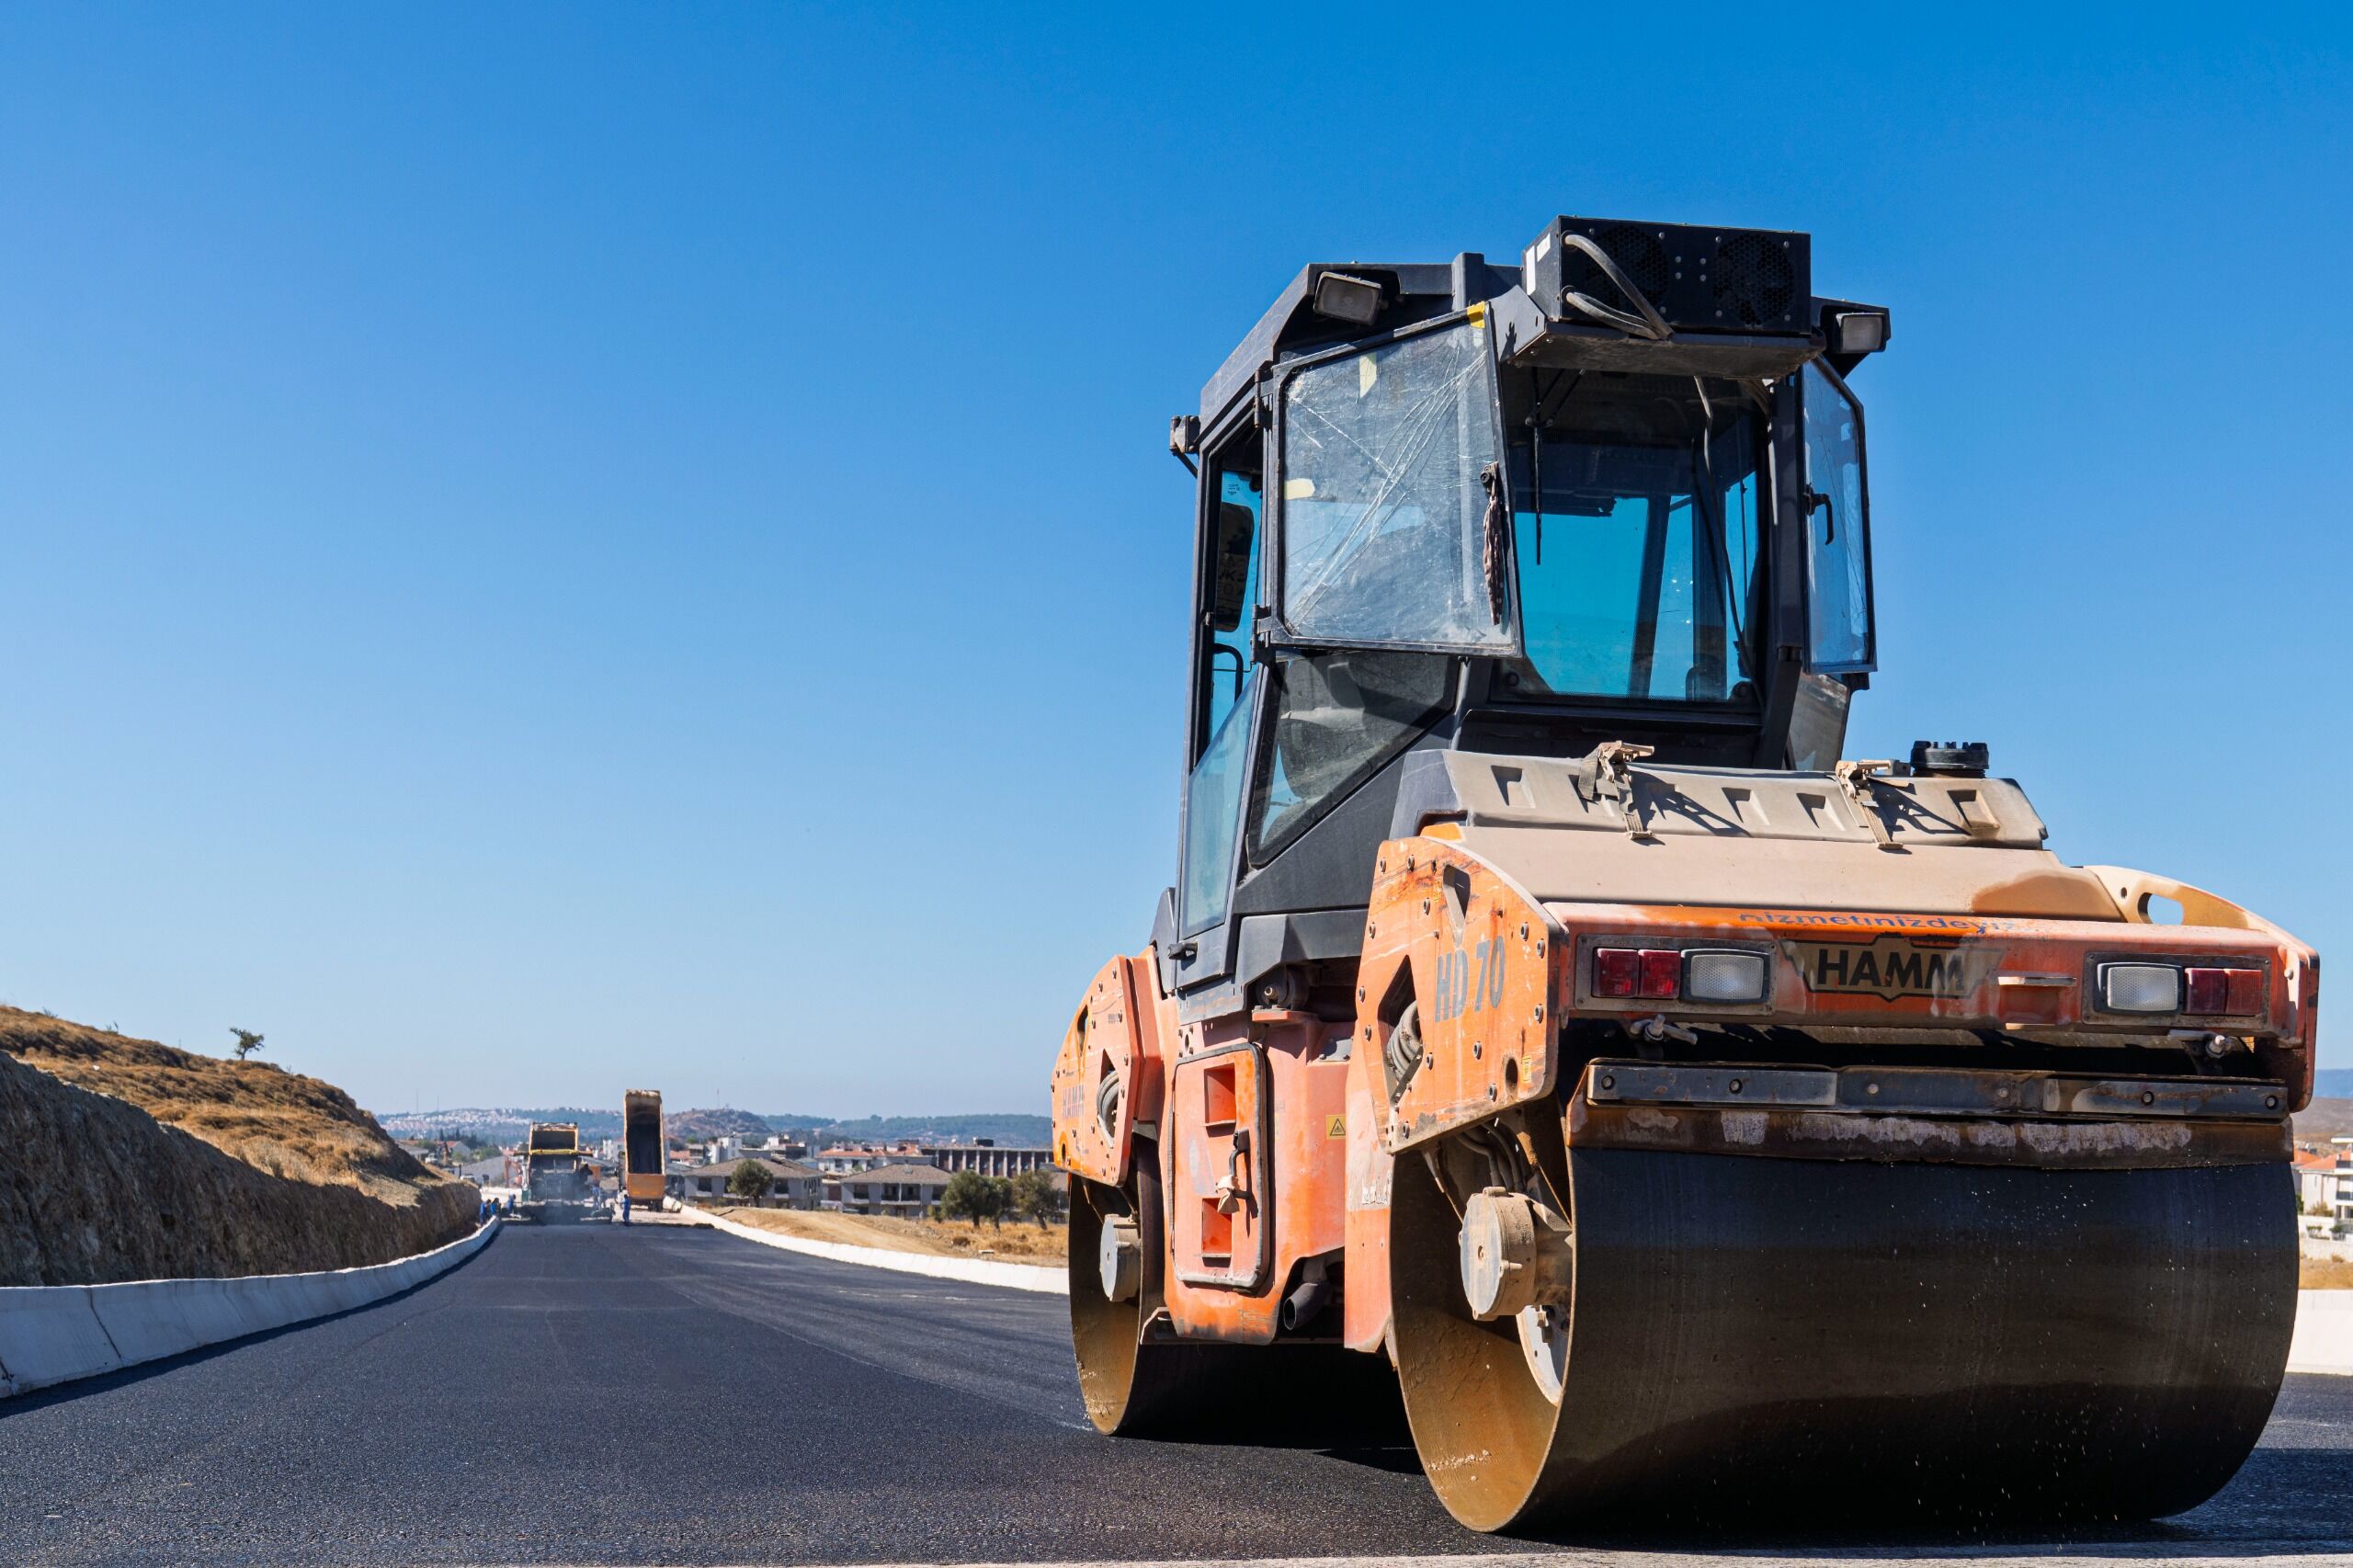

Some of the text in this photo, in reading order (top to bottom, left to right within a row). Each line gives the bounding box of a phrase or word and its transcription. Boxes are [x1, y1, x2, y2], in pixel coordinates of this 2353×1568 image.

[1435, 936, 1506, 1022] HD 70
[1817, 949, 1965, 991] HAMM
